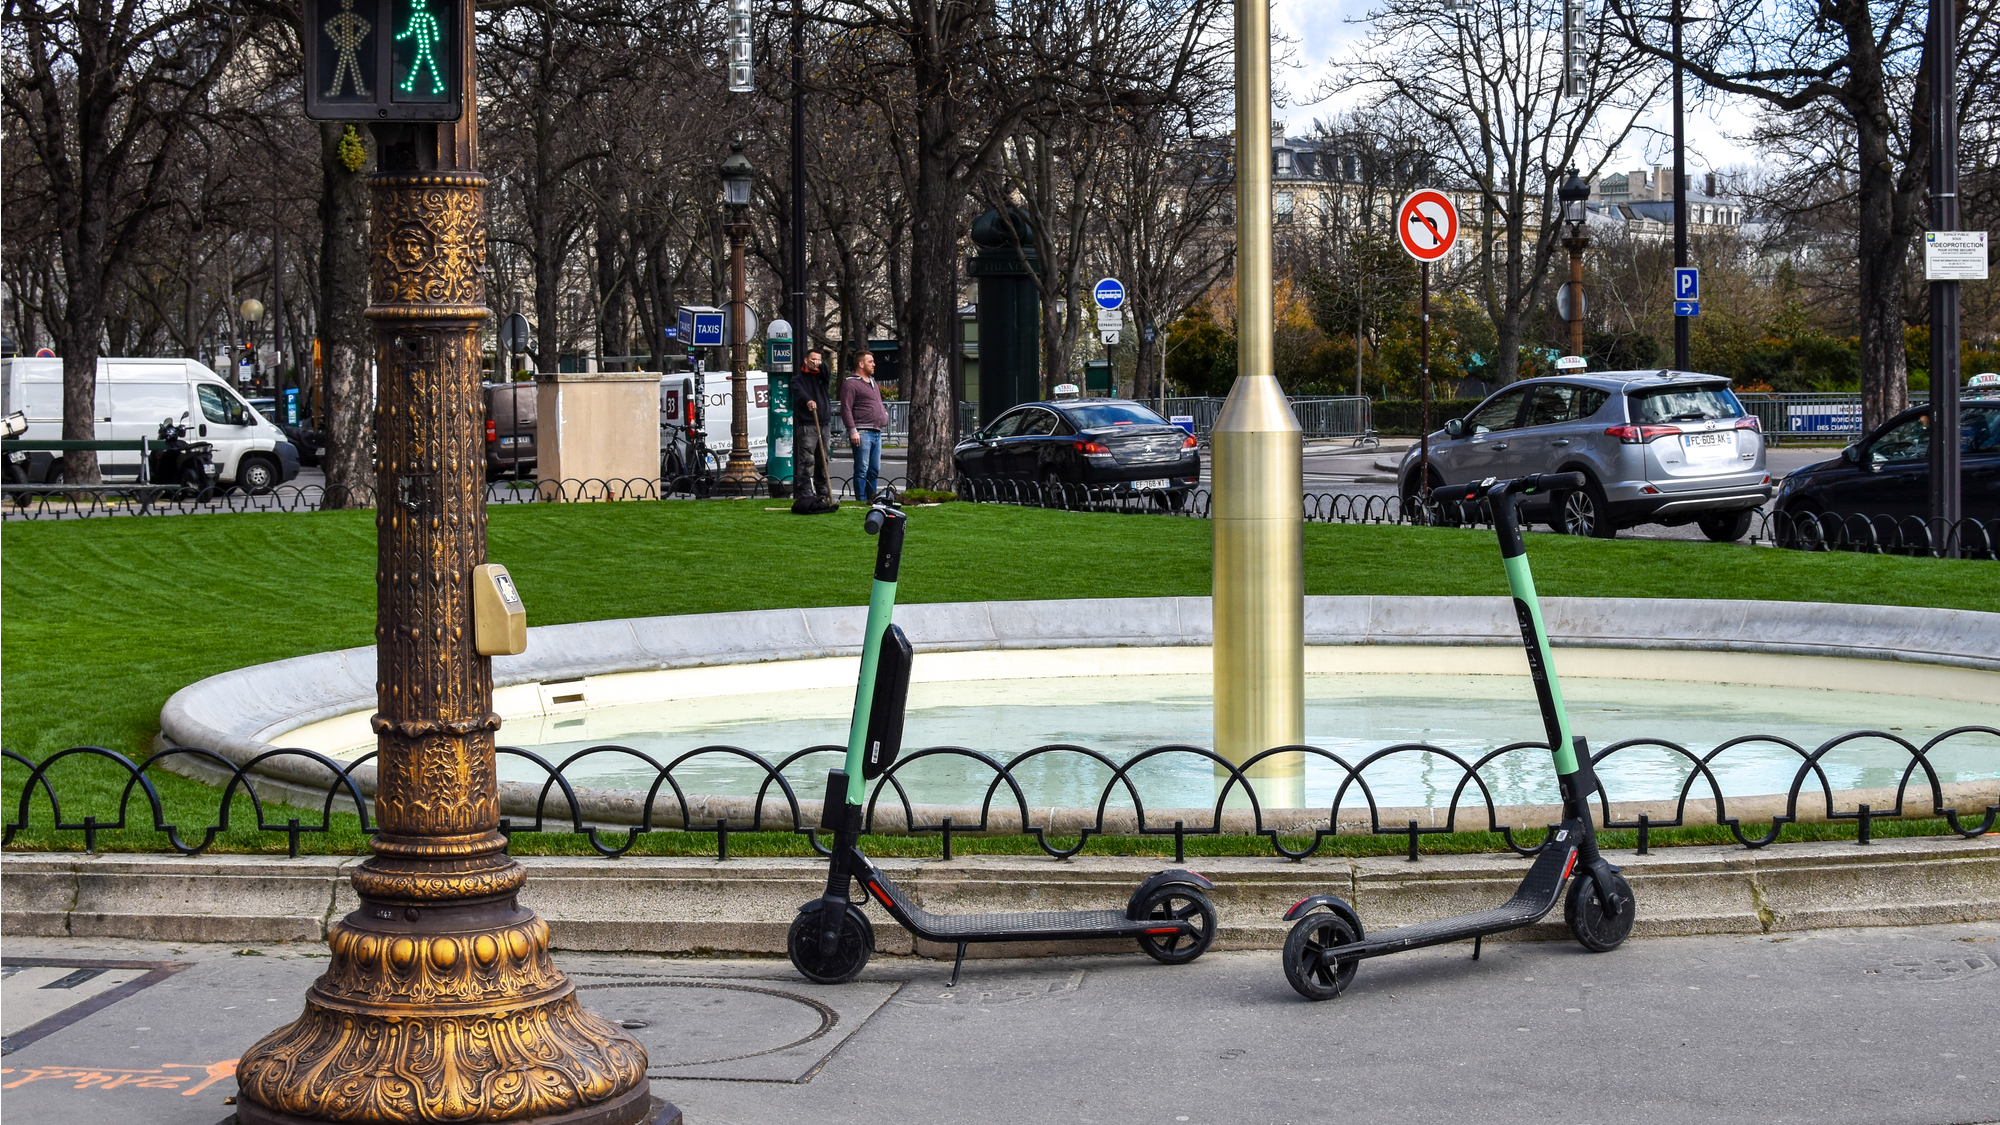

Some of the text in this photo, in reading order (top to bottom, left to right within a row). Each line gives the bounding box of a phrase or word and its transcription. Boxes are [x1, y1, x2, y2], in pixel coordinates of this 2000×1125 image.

[1682, 274, 1692, 294] P
[679, 320, 691, 333] TAXIS
[698, 324, 720, 334] TAXIS
[668, 398, 676, 413] 33
[1792, 418, 1802, 430] P
